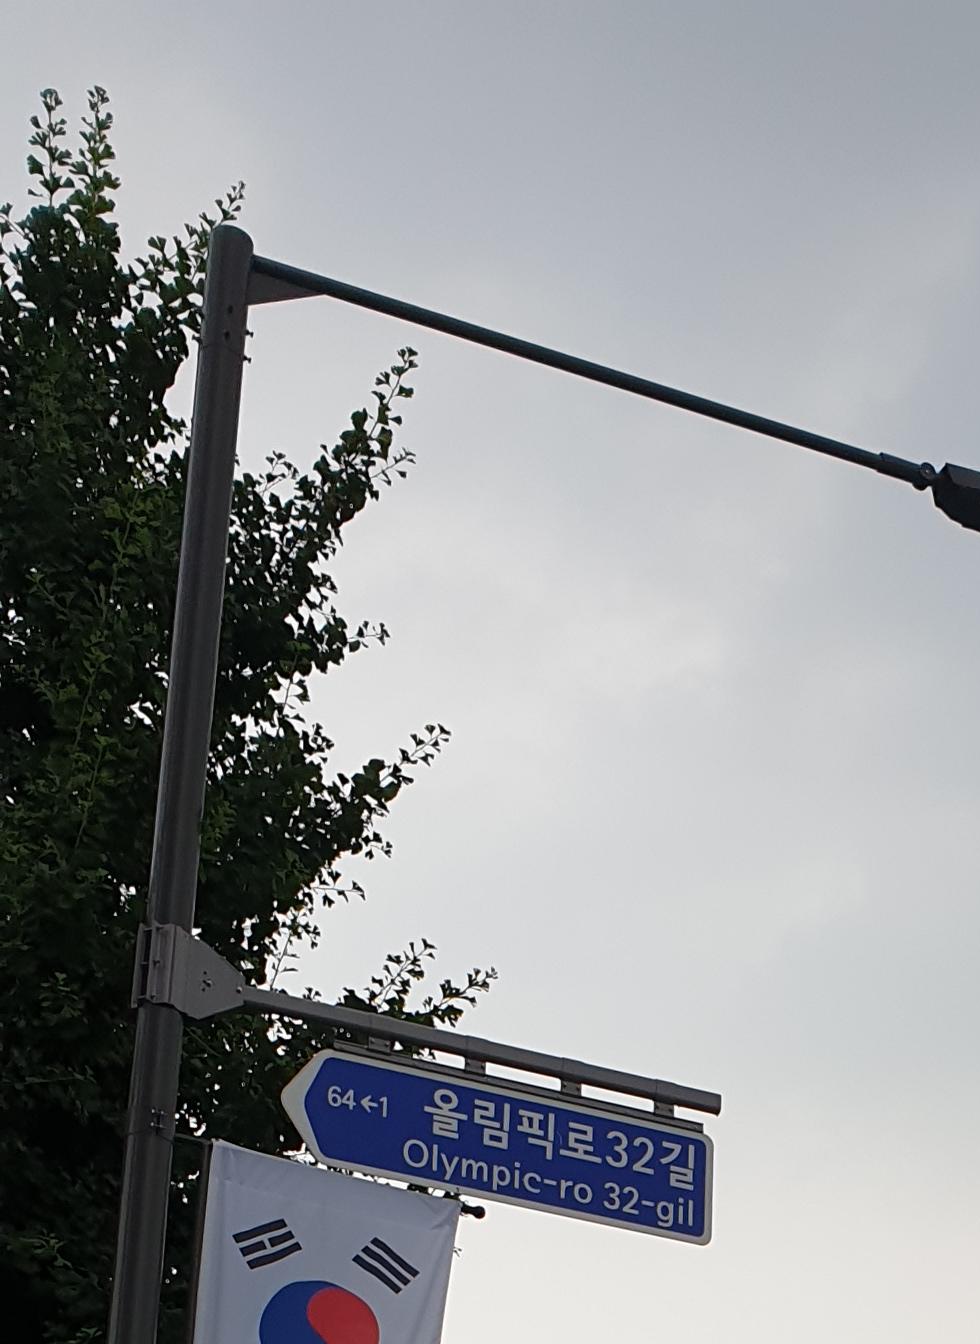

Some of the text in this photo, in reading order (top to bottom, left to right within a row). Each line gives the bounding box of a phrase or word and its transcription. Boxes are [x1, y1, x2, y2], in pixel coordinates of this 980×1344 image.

[327, 1085, 389, 1118] 64 1
[423, 1088, 696, 1191] 올림픽로32길
[402, 1138, 695, 1229] Olympic-ro 32-gil
